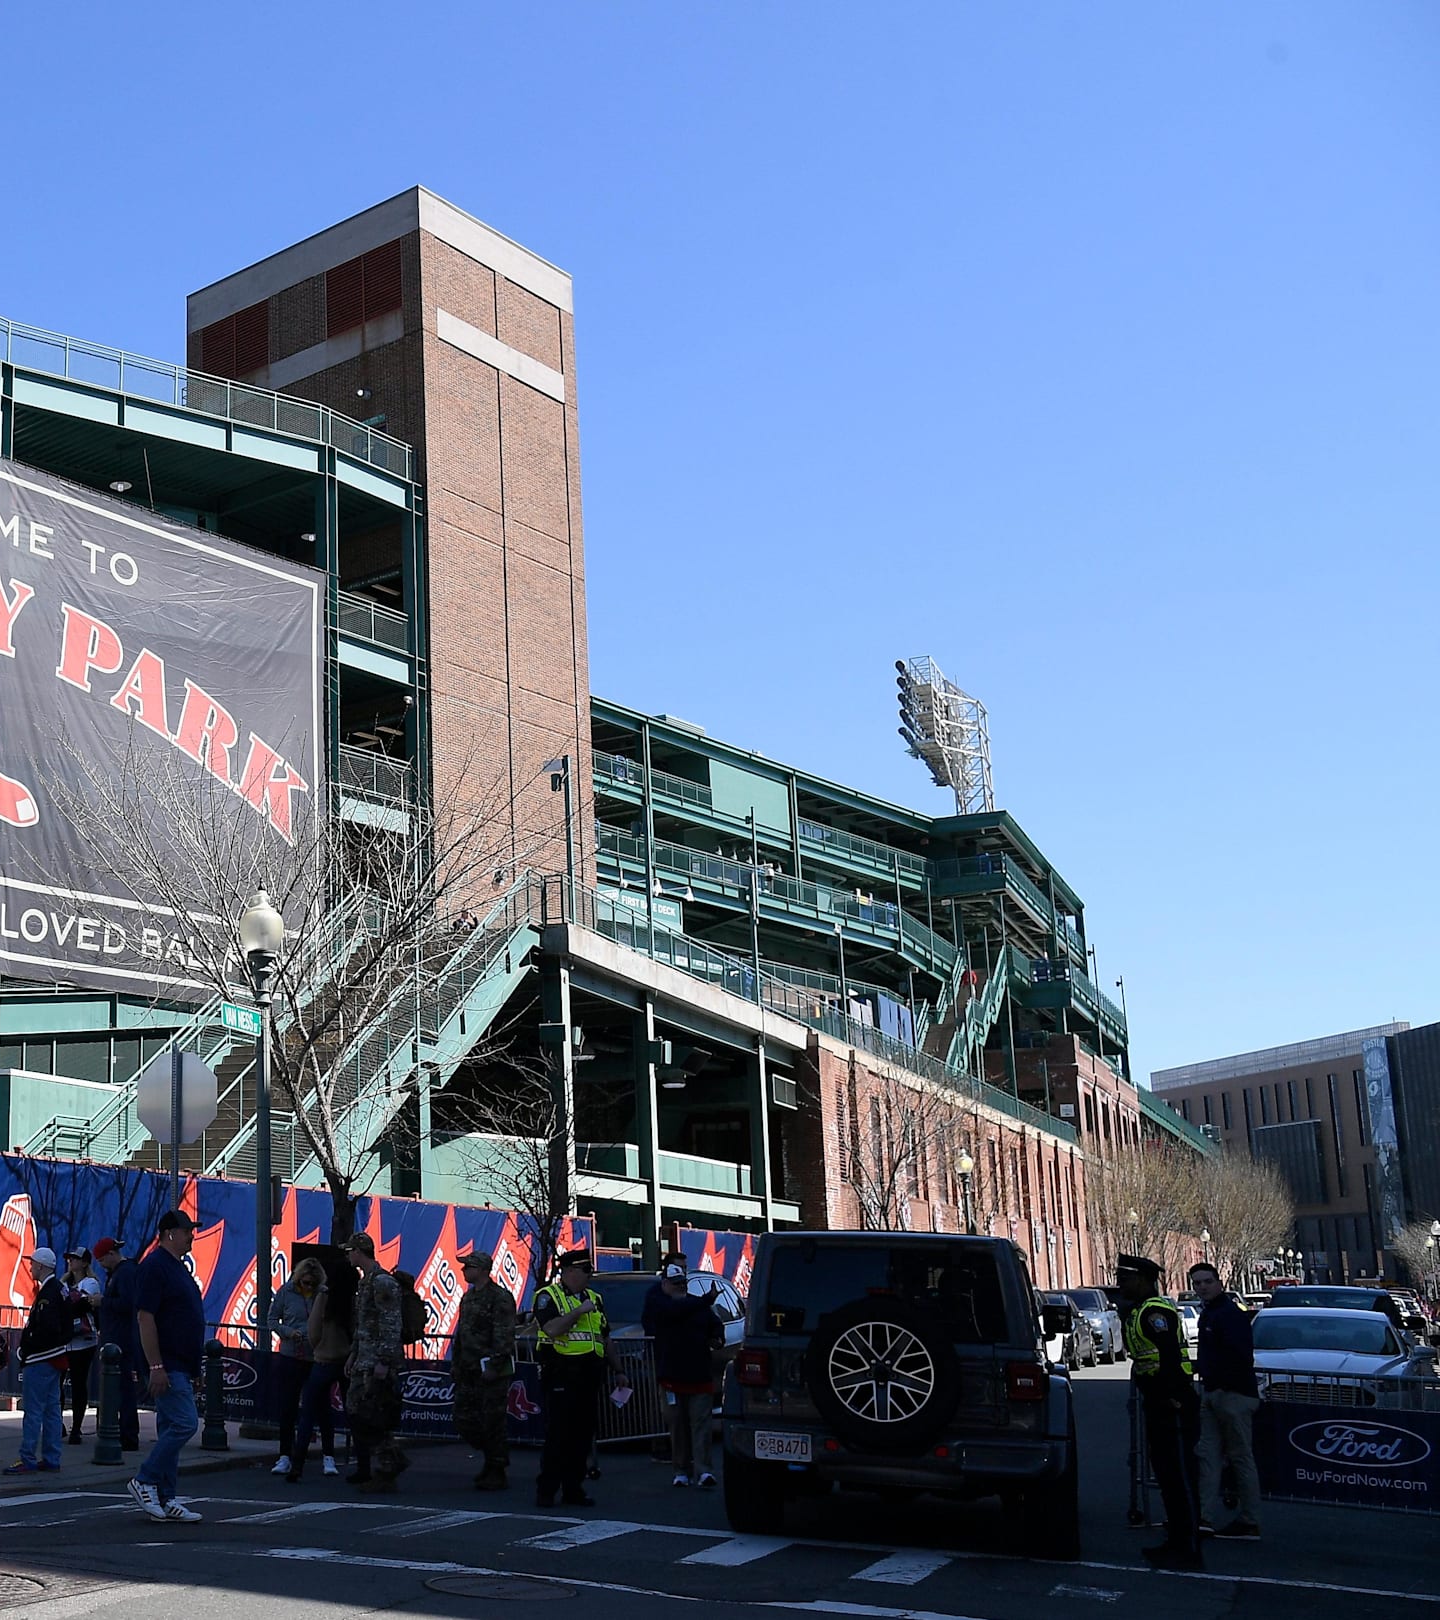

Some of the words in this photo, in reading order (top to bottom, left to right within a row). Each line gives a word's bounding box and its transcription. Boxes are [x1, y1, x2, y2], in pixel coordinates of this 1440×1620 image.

[81, 540, 139, 586] TO
[56, 602, 309, 848] PARK
[621, 895, 639, 908] FIRST
[641, 899, 657, 912] BE
[658, 904, 676, 916] DECK
[497, 1251, 518, 1292] 18
[403, 1374, 456, 1400] Ford
[400, 1410, 453, 1422] yFordNow.c
[1315, 1425, 1402, 1461] Ford
[1295, 1468, 1428, 1491] BuyFordNow.com
